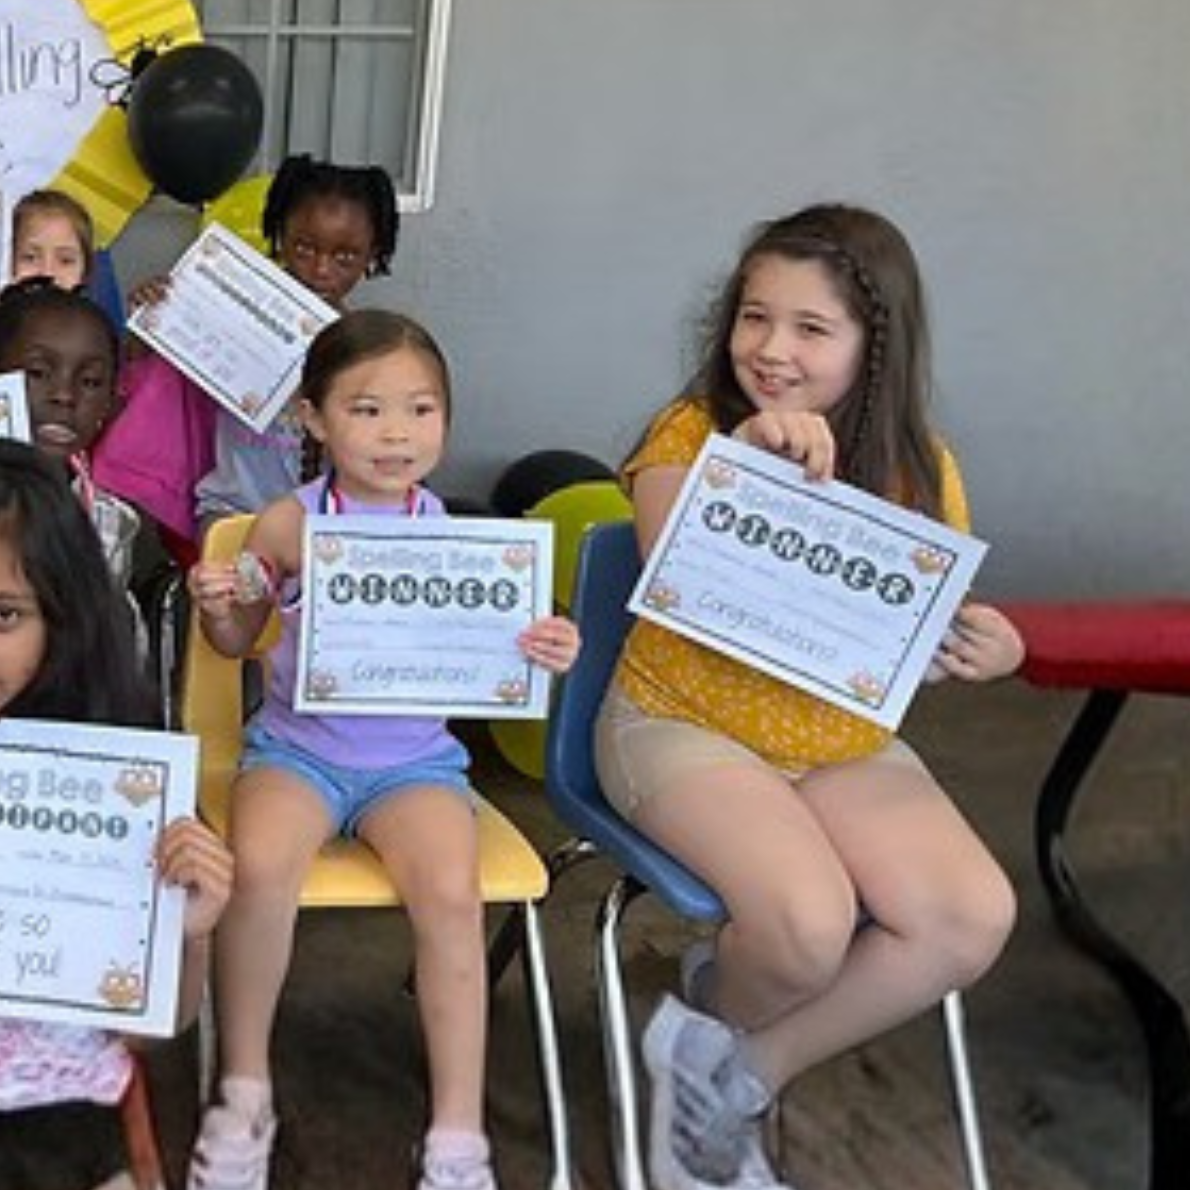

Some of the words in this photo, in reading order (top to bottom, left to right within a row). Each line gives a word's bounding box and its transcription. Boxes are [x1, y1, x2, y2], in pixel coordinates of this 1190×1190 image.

[702, 501, 915, 605] WINNER
[327, 573, 520, 612] WINNER
[36, 767, 103, 804] Bee
[19, 913, 51, 939] so
